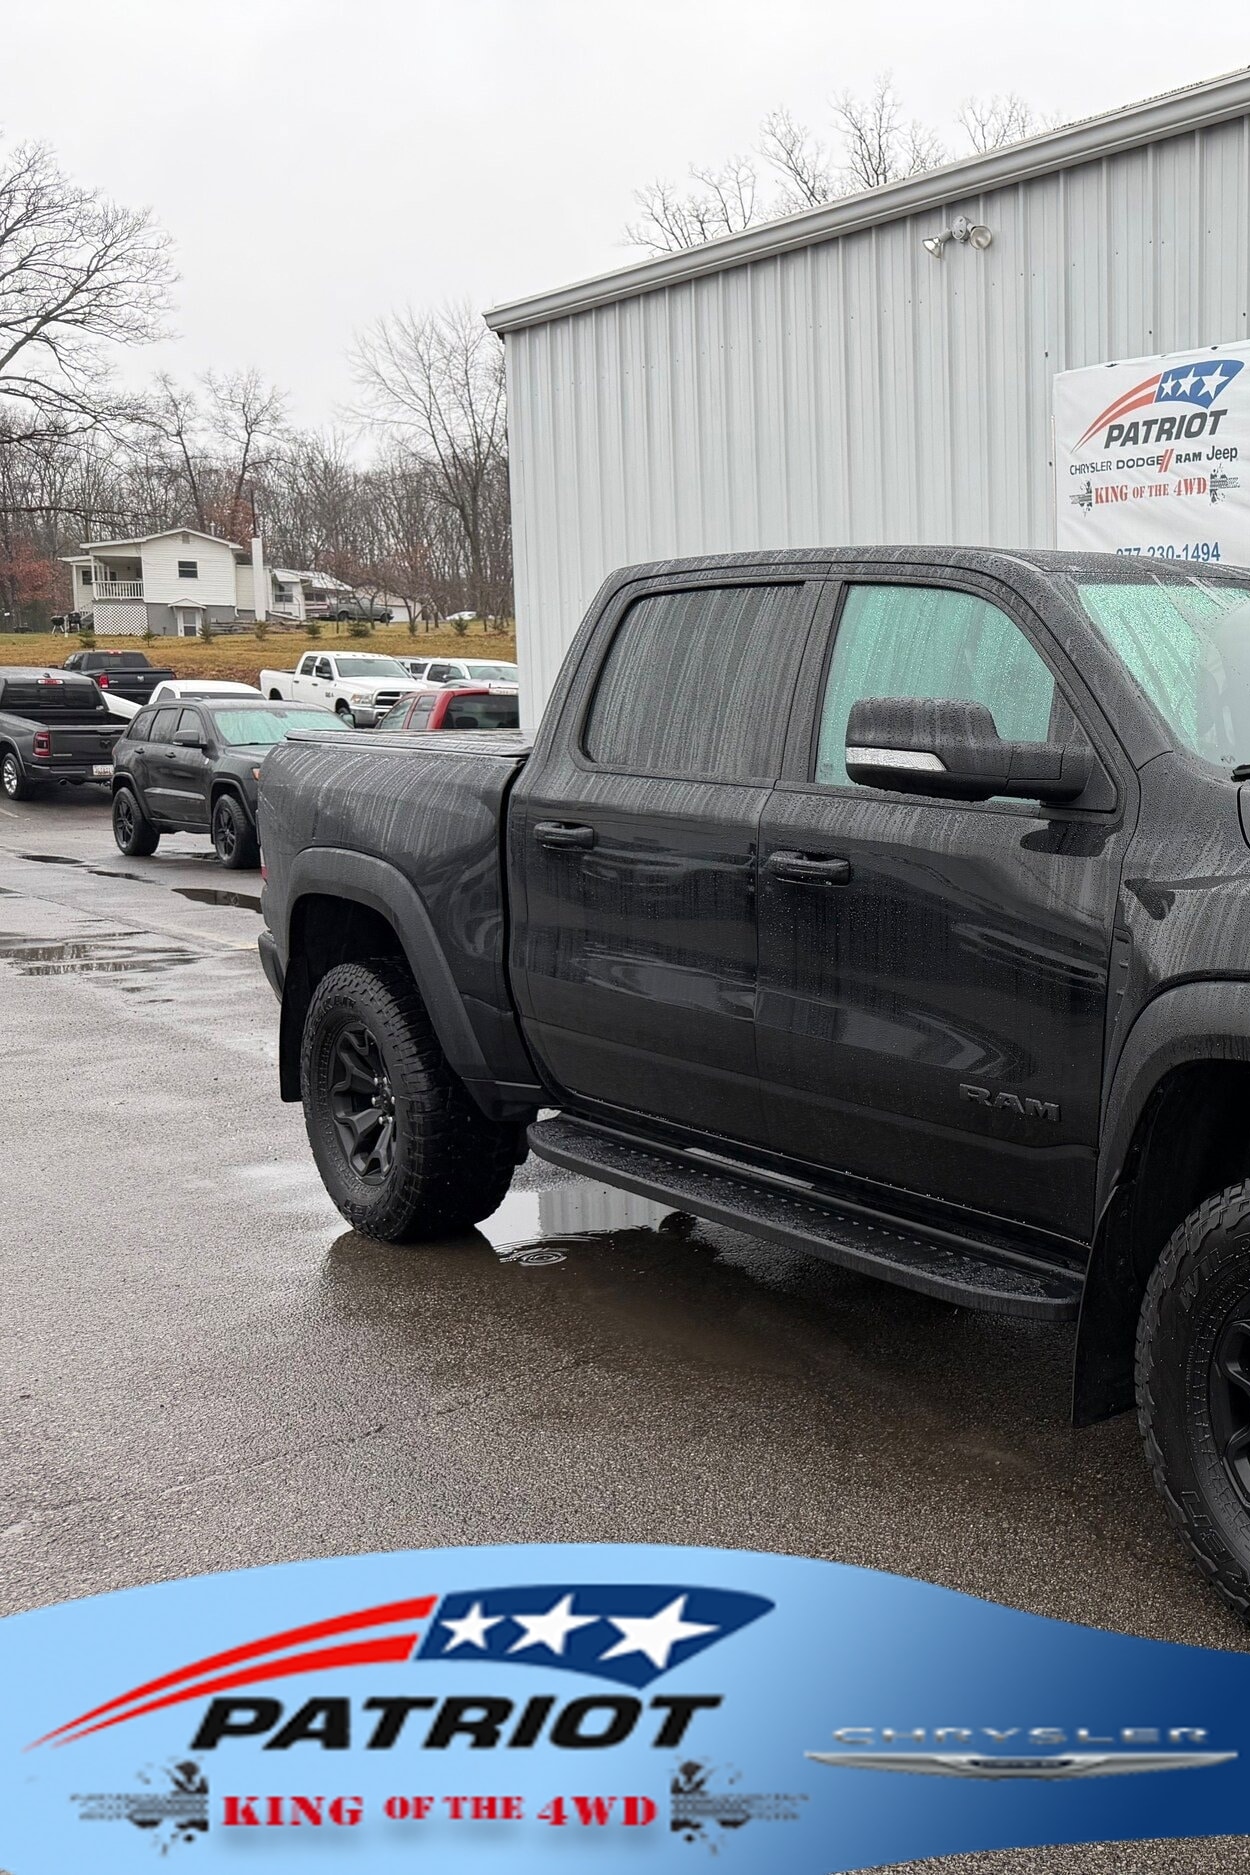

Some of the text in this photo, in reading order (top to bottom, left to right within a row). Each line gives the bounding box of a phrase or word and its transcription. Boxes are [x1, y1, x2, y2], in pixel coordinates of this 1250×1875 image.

[1104, 409, 1227, 449] PATRIOT
[1069, 445, 1238, 476] CHRYSLER DODGE RAM Jeep
[1094, 476, 1207, 504] KING OF THE 4WD
[960, 1084, 1060, 1121] RAM
